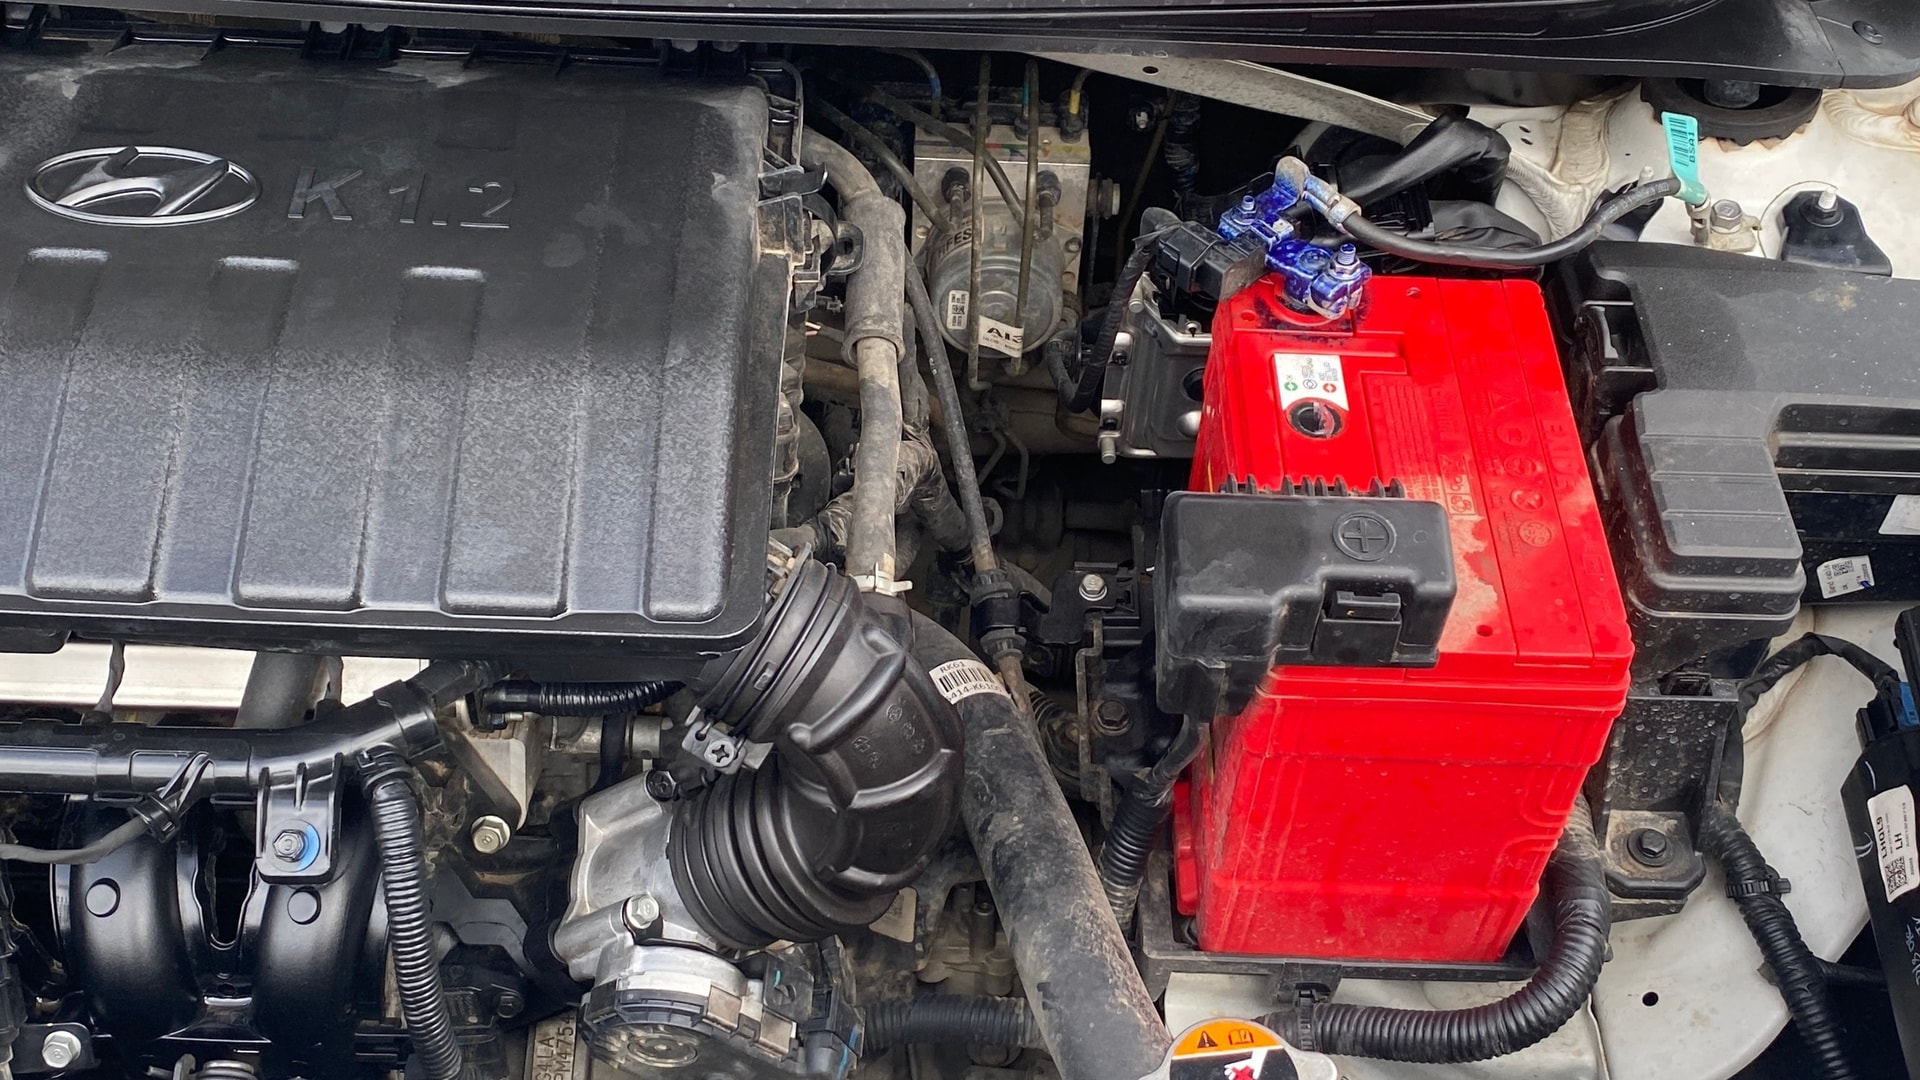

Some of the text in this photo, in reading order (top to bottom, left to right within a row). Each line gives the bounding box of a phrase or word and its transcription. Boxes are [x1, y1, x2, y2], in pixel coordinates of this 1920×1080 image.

[287, 167, 517, 230] K 1.2
[940, 661, 965, 673] RK61
[1894, 833, 1903, 850] LH
